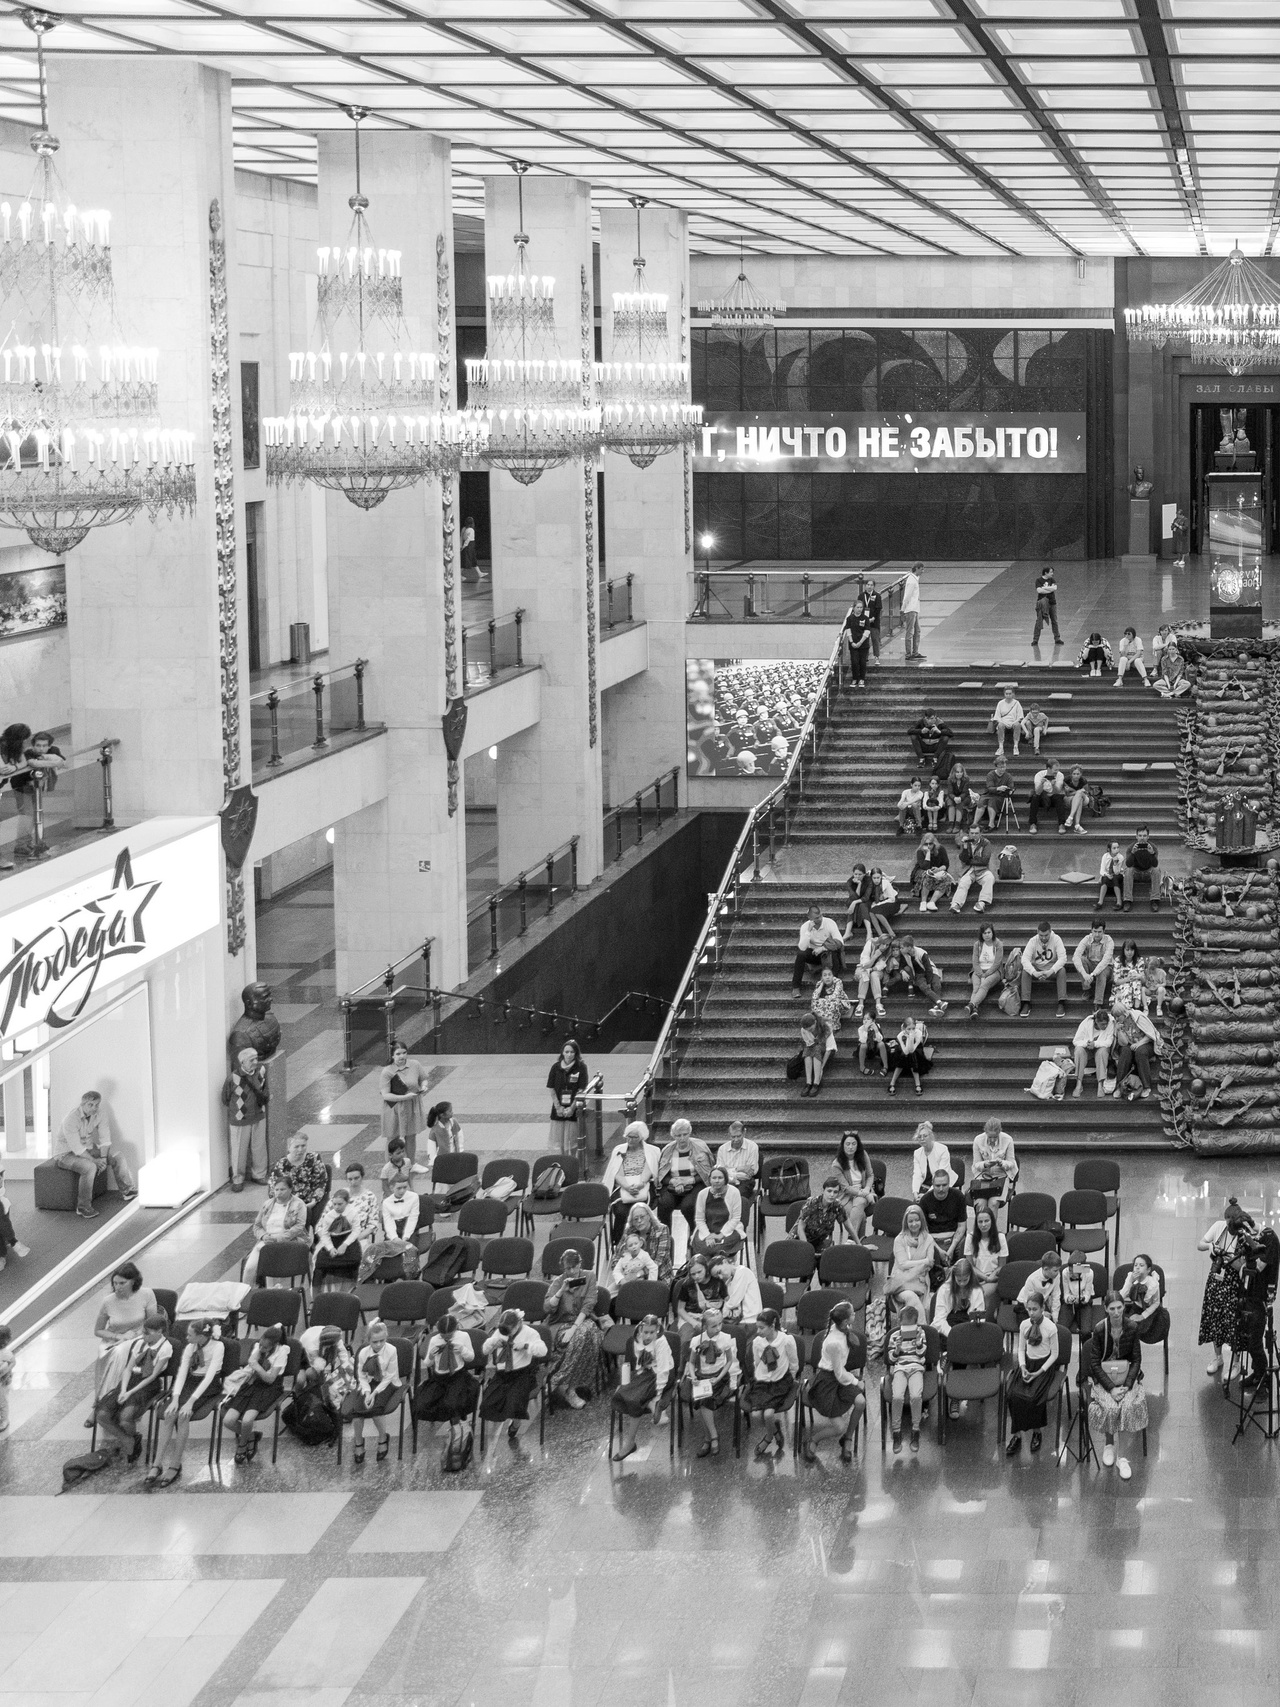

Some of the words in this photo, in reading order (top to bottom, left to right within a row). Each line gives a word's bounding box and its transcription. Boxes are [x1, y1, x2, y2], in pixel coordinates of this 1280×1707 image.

[1196, 384, 1221, 393] ЗАЛ
[1228, 384, 1274, 393] СЛАВЫ
[692, 427, 726, 462] Т,
[736, 426, 847, 459] НИЧТО
[858, 426, 900, 458] НЕ
[910, 426, 1059, 459] ЗАБЫТО!
